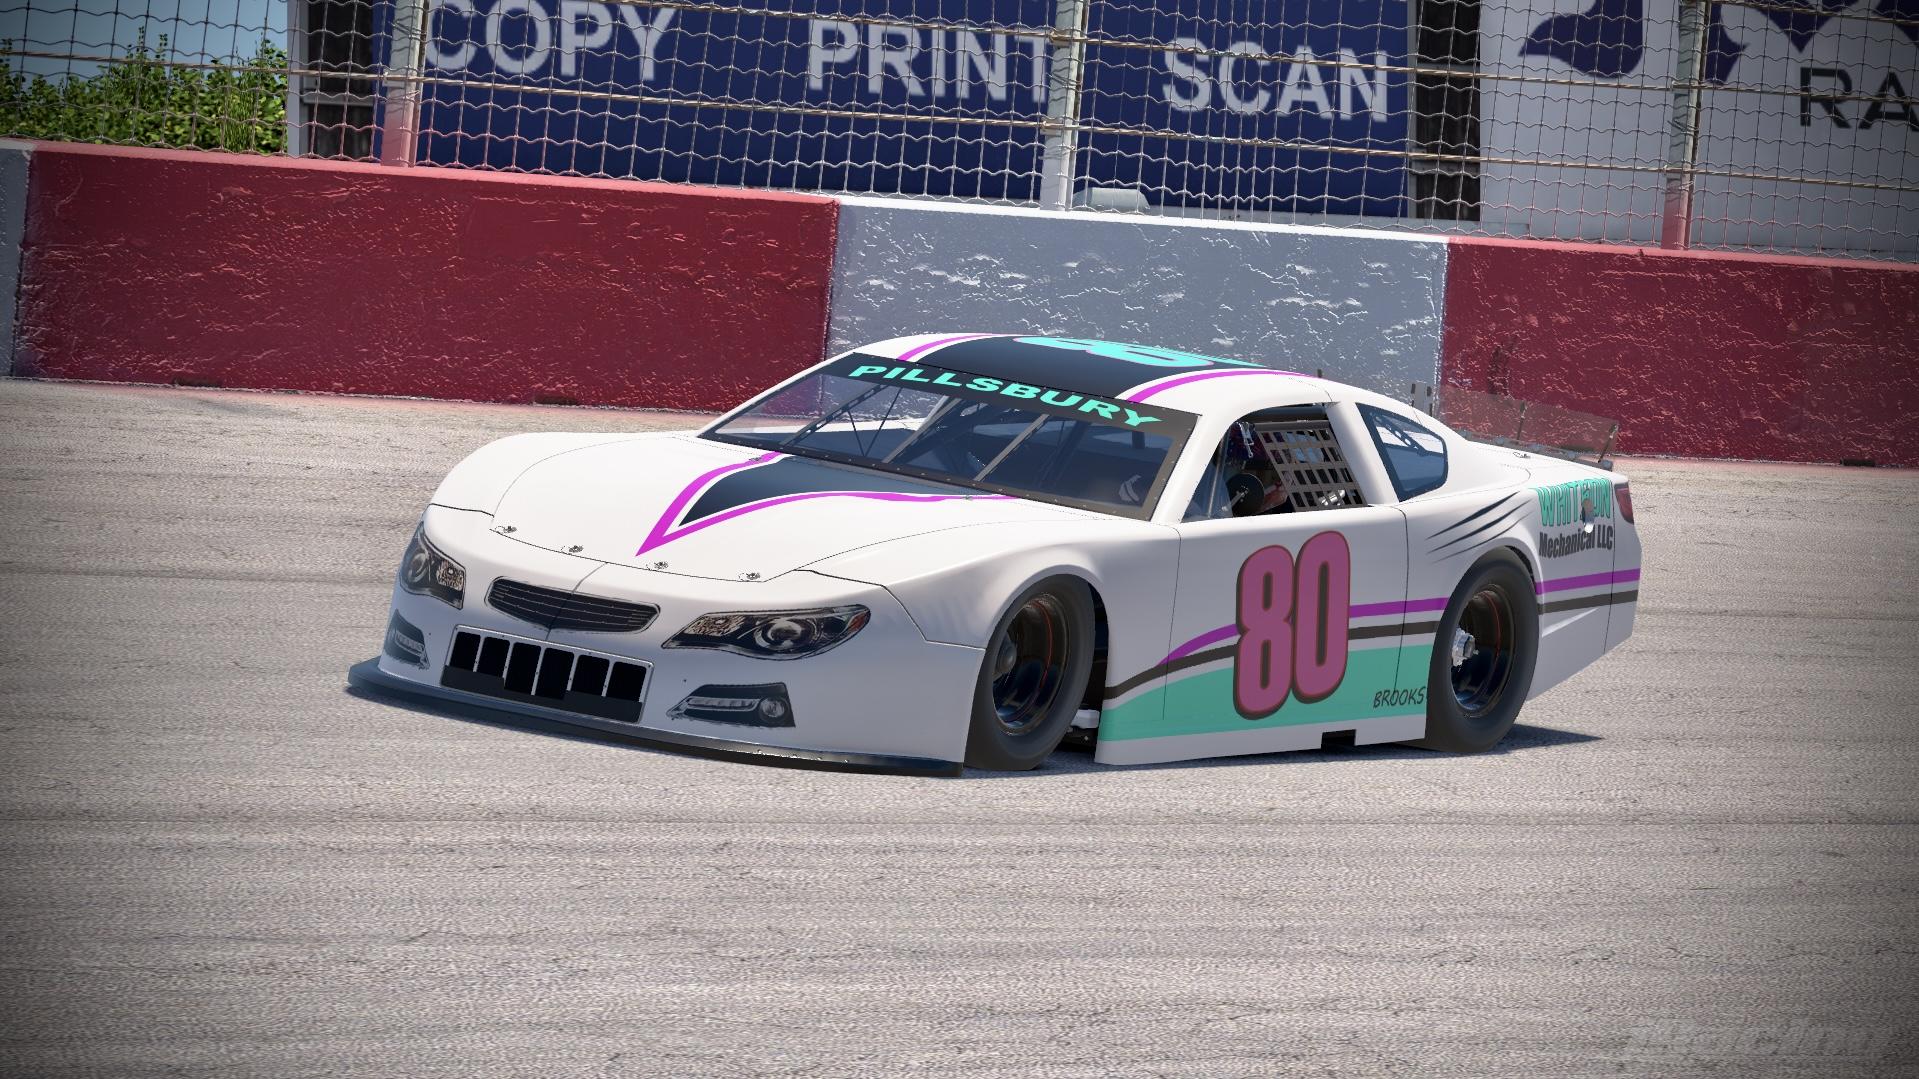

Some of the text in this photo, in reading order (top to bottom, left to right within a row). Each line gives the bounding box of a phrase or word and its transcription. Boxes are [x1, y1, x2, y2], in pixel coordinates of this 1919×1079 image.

[425, 0, 1388, 123] COPY PRINT SCAN
[1800, 67, 1919, 132] RA
[848, 364, 1162, 427] PILLSBURY
[1539, 523, 1614, 559] Mechanical LLC
[1233, 530, 1350, 720] 80
[1373, 686, 1426, 709] BROOKS
